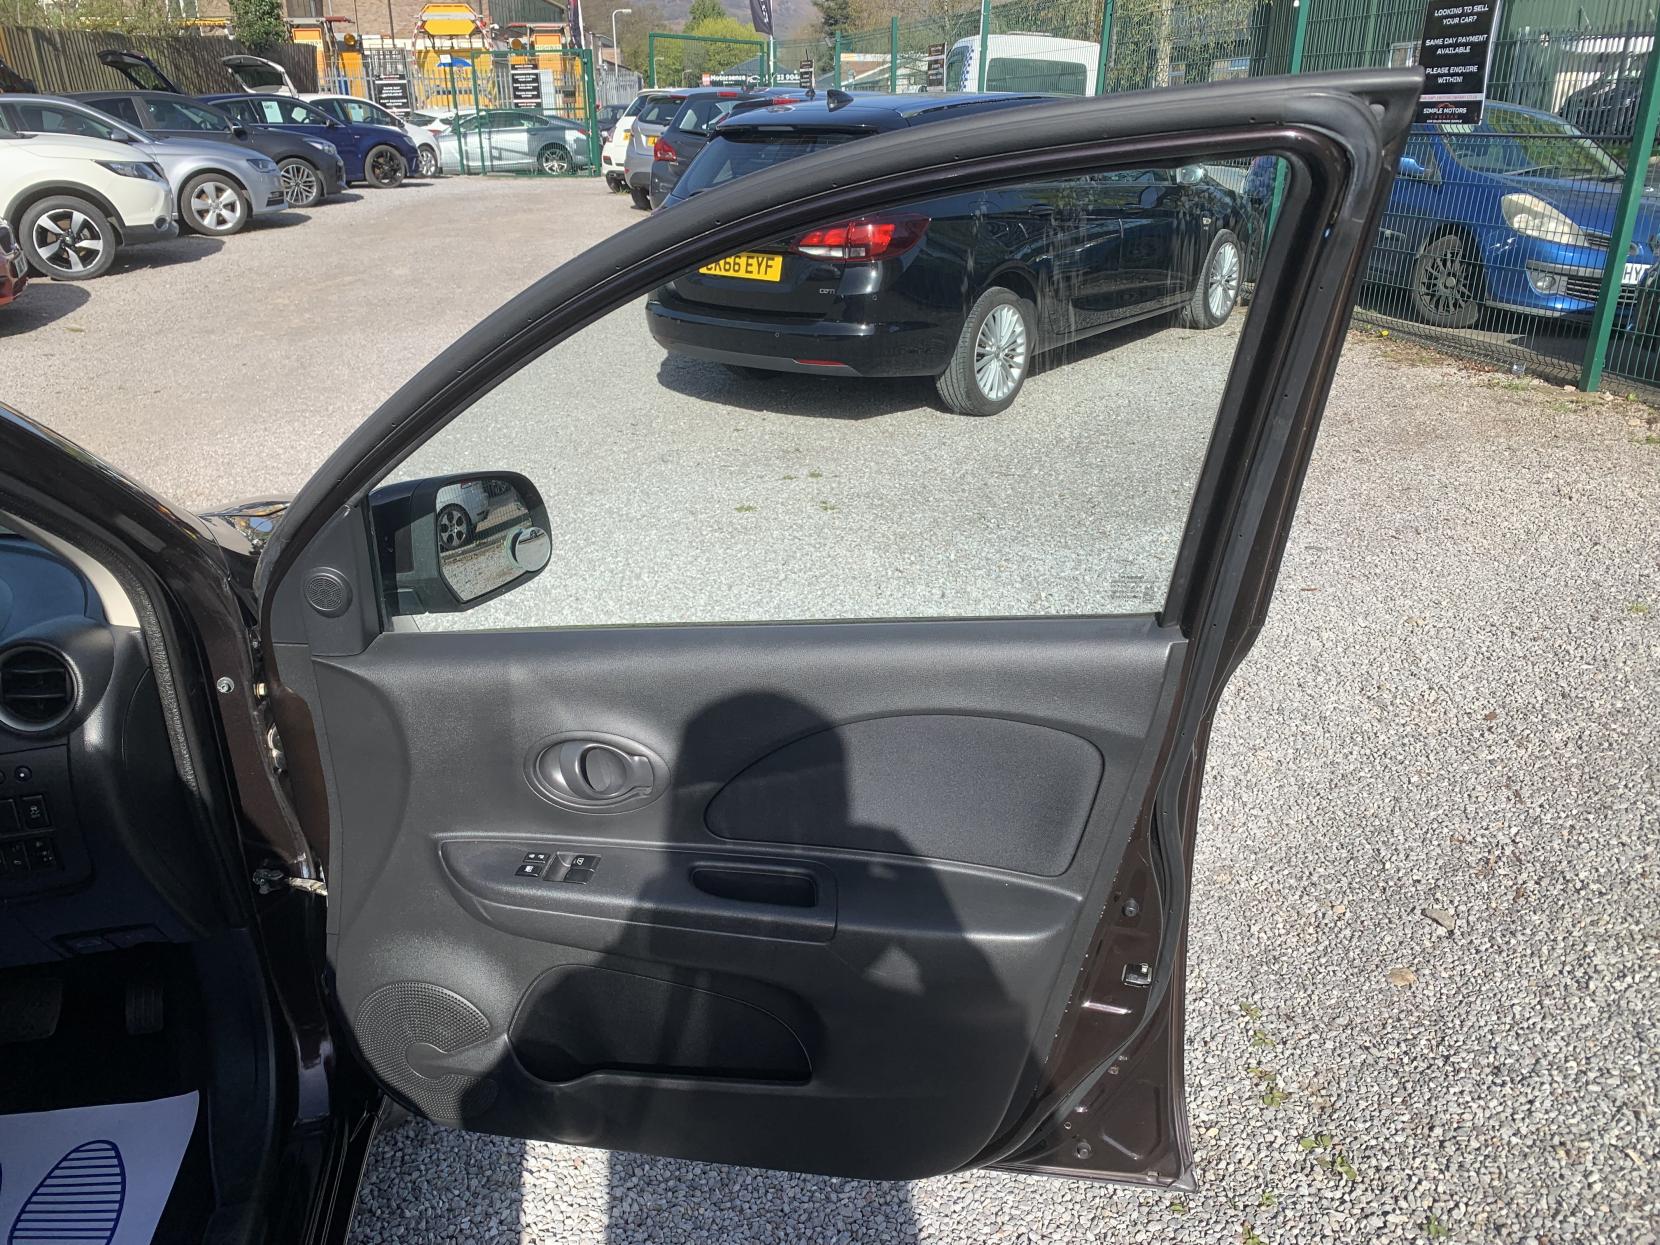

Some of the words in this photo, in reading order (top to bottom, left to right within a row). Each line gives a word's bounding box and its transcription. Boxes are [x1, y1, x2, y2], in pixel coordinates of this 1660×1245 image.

[1434, 7, 1463, 16] LOOKING
[1473, 4, 1489, 12] SELL
[1442, 17, 1460, 25] YOUR
[1425, 38, 1444, 46] SAME
[1458, 34, 1488, 43] PAYMENT
[1436, 46, 1471, 54] AVAILABLE
[1425, 66, 1449, 74] PLEASE
[1449, 65, 1478, 73] ENQUIRE
[745, 256, 775, 275] EYF
